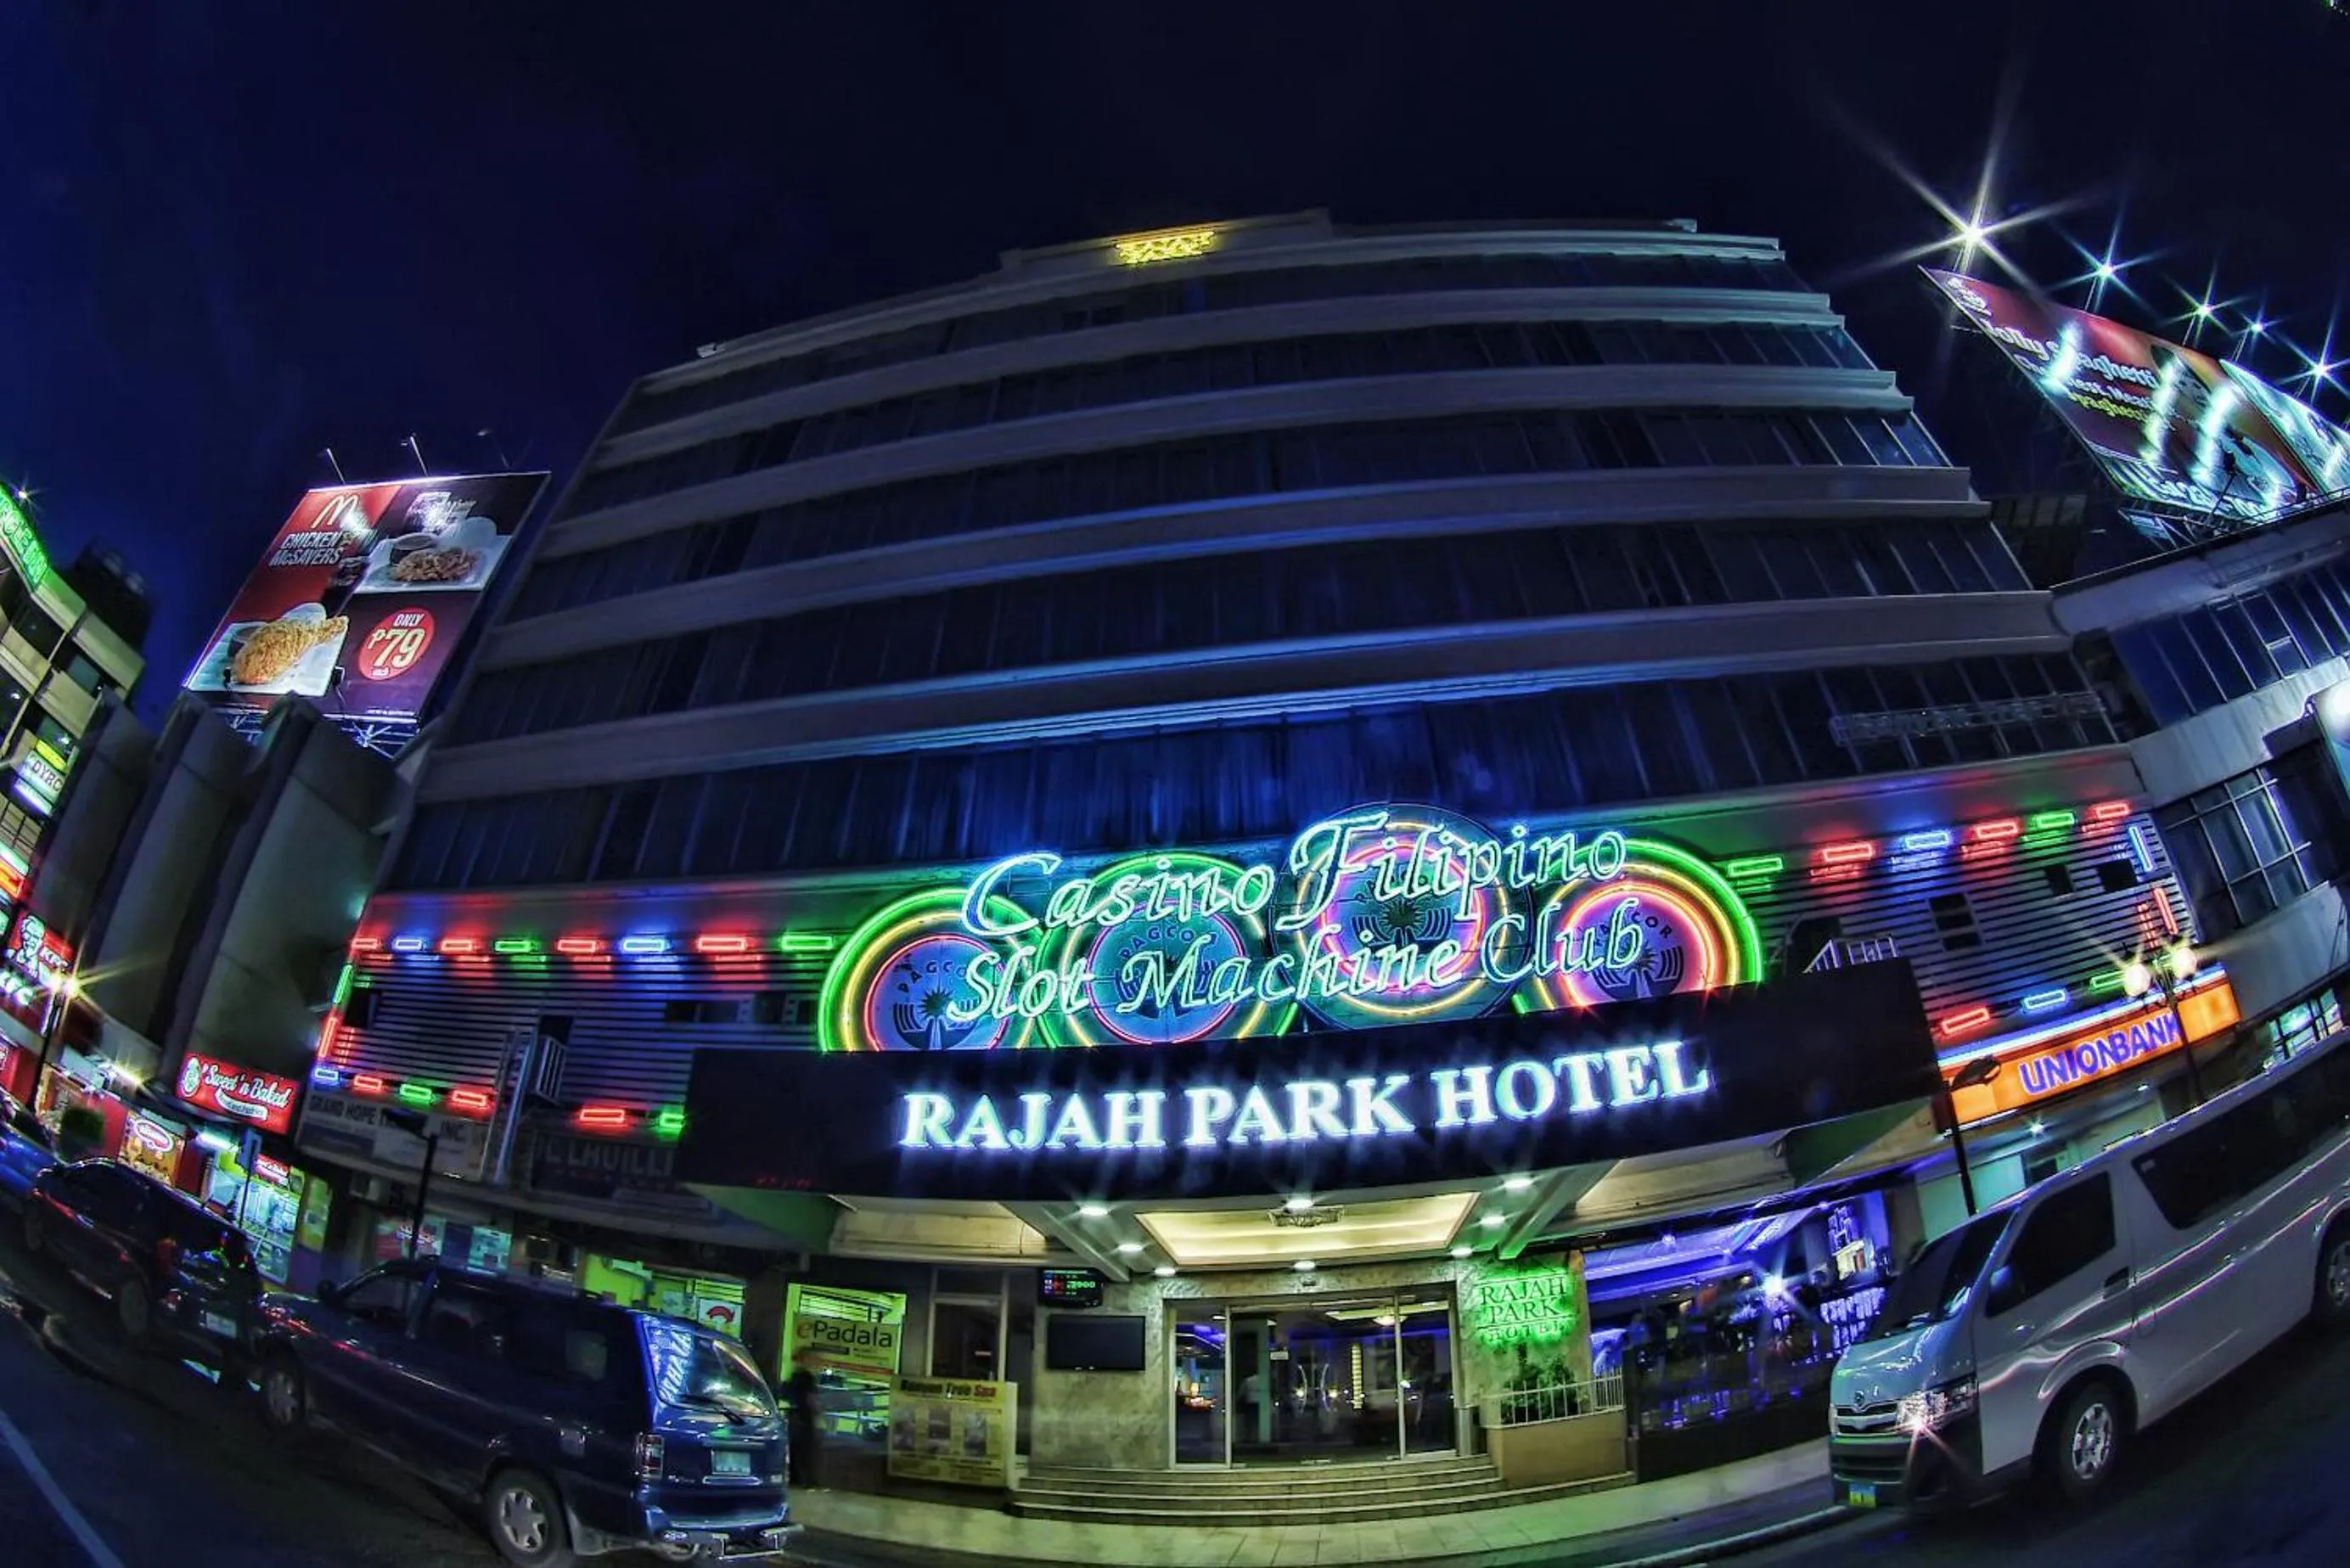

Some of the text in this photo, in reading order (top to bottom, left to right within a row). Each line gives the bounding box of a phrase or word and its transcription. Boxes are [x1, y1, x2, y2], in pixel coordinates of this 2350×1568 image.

[279, 531, 342, 549] CHICKEN
[393, 612, 424, 627] ONLY
[959, 851, 1275, 936] Casino
[1274, 810, 1628, 930] Filipino
[946, 896, 1644, 1021] Slot Machine Club
[897, 959, 969, 994] PAGCO
[2018, 1007, 2186, 1096] UNIONBANK
[250, 1076, 293, 1109] Baked
[900, 1040, 1710, 1150] RAJAH PARK HOTEL
[1480, 1276, 1567, 1306] RAJAH
[1487, 1297, 1560, 1324] PARK
[796, 1320, 893, 1348] ePadala
[1480, 1320, 1566, 1341] HOTEL
